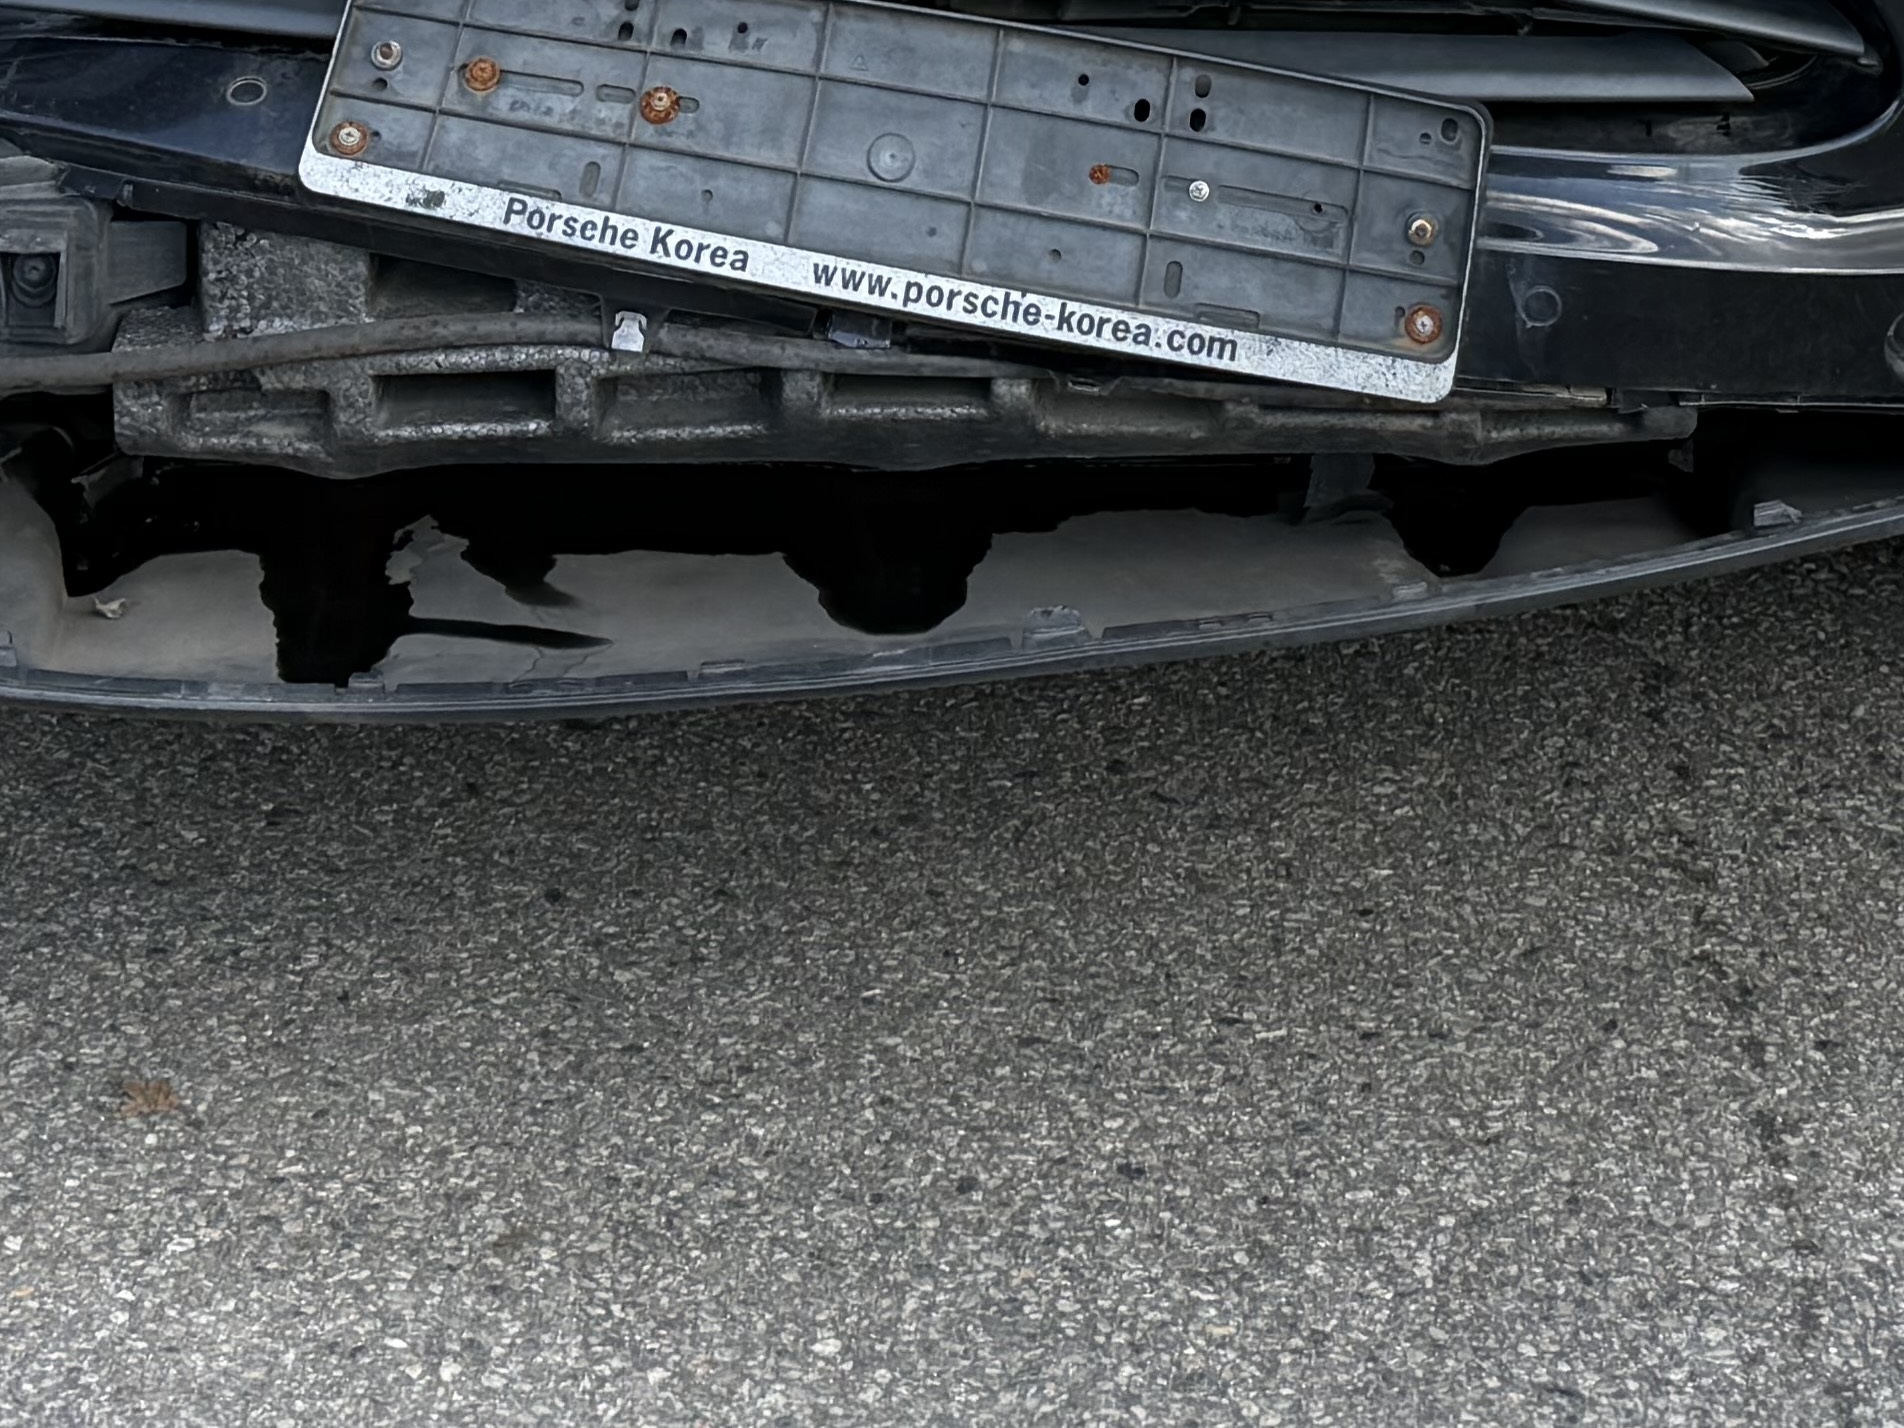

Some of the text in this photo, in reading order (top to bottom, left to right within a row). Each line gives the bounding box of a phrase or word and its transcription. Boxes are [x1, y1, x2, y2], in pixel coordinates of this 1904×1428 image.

[503, 197, 1238, 362] Porsche Korea www.porsche-korea.com
